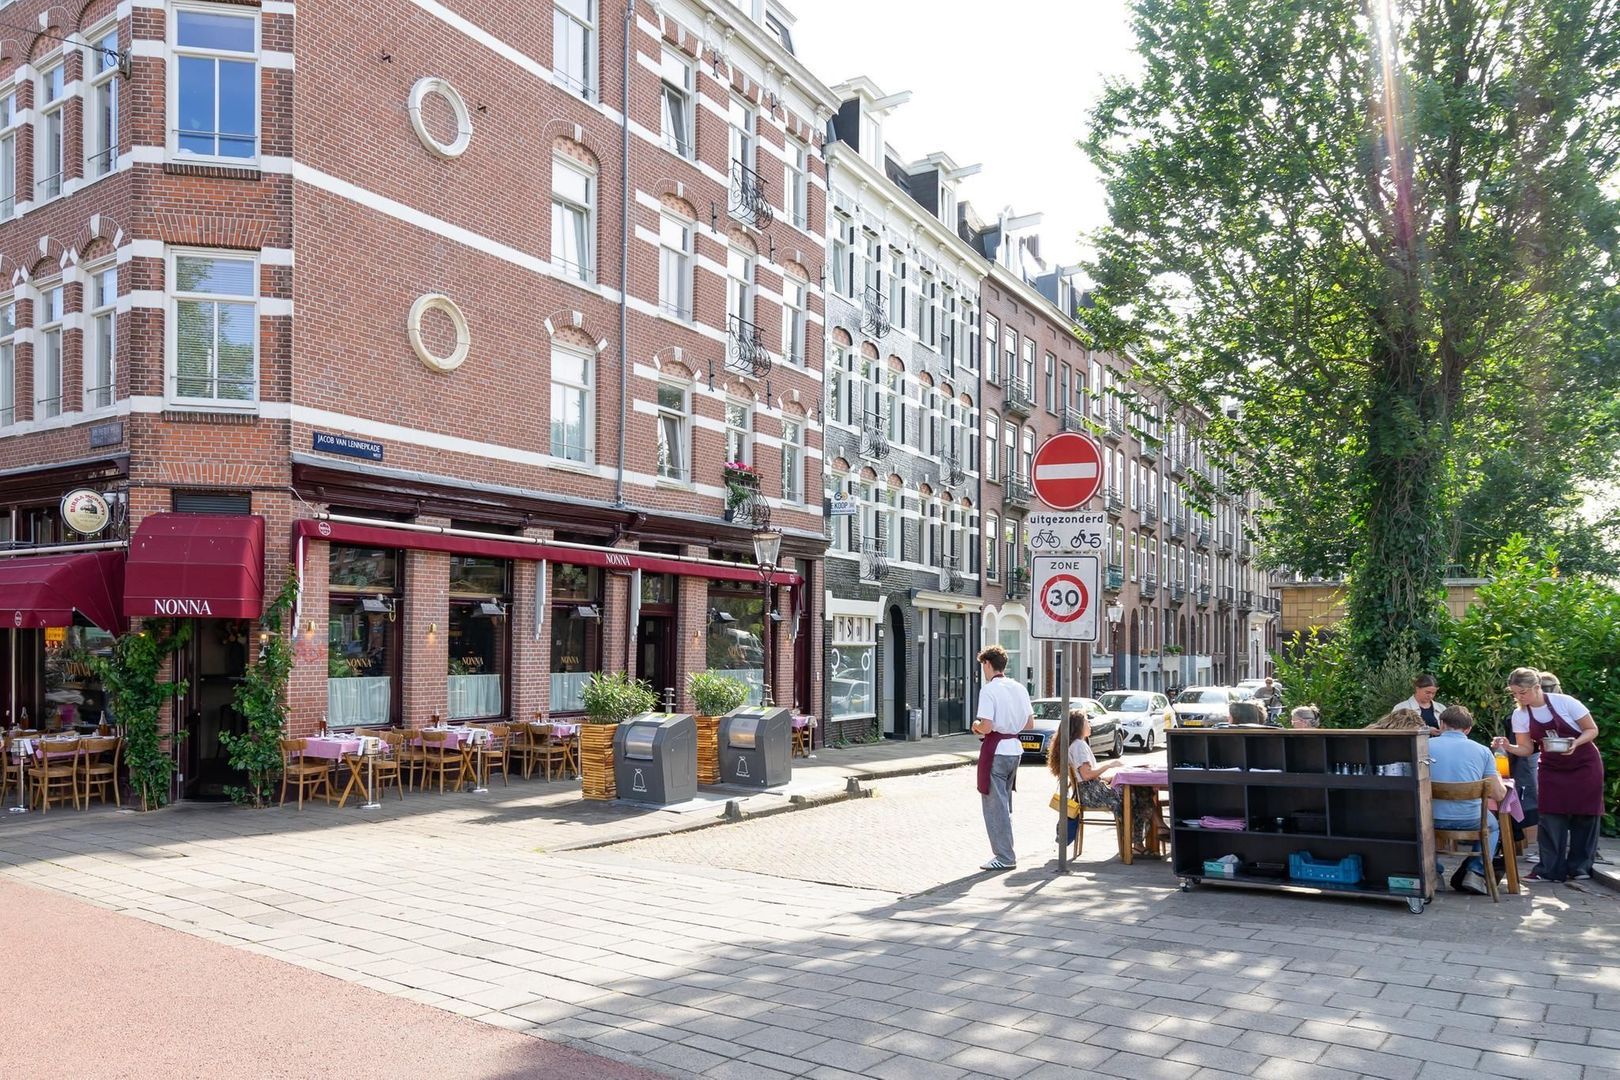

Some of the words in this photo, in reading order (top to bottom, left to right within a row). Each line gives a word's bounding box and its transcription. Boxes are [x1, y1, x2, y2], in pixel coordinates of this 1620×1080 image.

[317, 434, 335, 444] JACOB
[335, 437, 347, 447] VAN
[347, 440, 381, 453] LENNEPKADE
[70, 495, 85, 513] BIRRA
[834, 501, 849, 509] KOOP
[1030, 514, 1104, 527] uitgezonderd
[605, 552, 631, 566] NONNA
[1050, 561, 1080, 570] ZONE
[1049, 589, 1080, 607] 30
[154, 598, 213, 615] NONNA
[346, 657, 373, 668] NONNA
